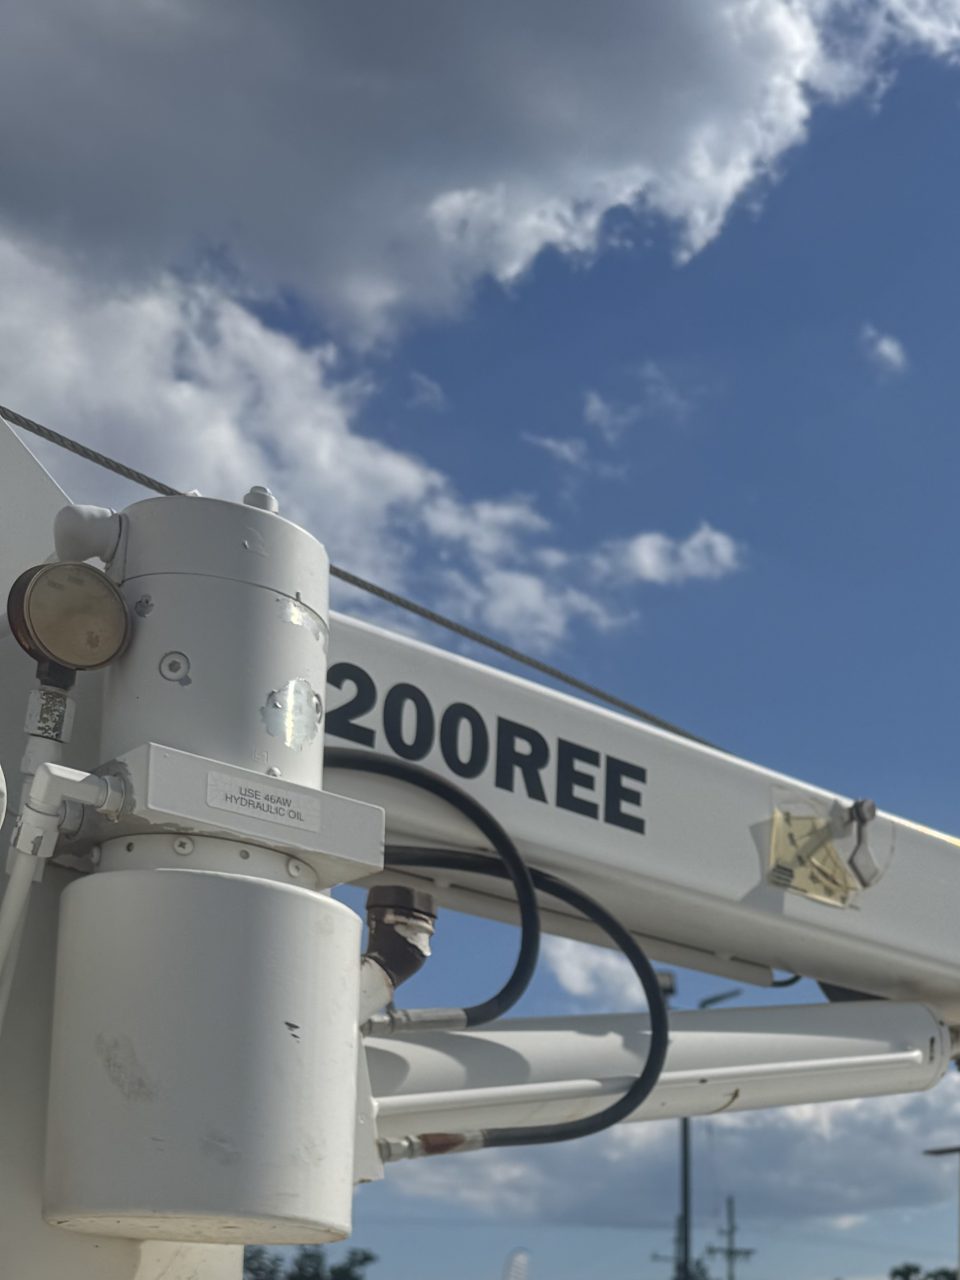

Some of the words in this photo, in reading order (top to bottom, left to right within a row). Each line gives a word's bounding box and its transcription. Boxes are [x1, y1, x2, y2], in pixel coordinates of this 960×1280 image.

[225, 793, 286, 817] HYDRAULIC
[288, 809, 305, 822] OIL
[239, 786, 261, 800] USE
[264, 793, 292, 807] 46AW
